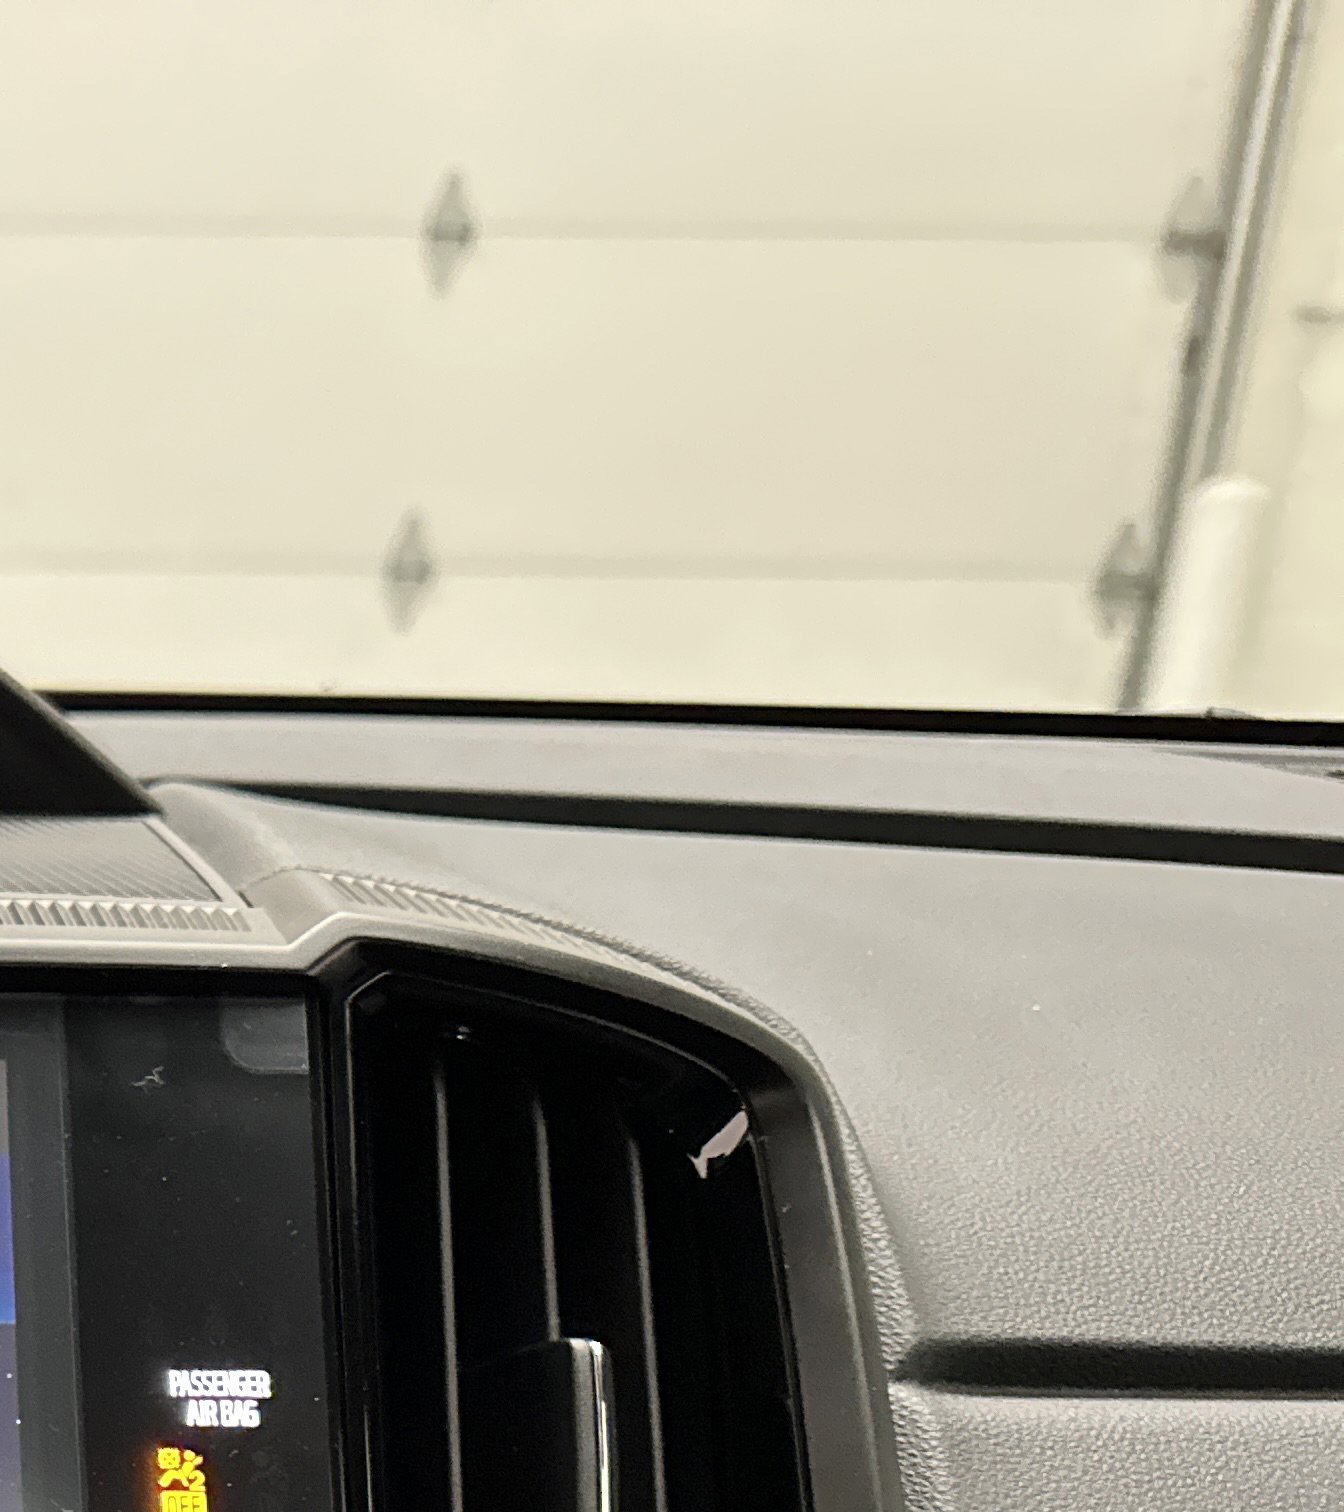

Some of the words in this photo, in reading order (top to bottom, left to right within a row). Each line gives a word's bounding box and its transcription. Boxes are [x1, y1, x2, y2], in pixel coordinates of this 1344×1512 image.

[168, 1369, 272, 1398] PASSENGER
[186, 1400, 219, 1427] AIR
[220, 1400, 261, 1427] BAG
